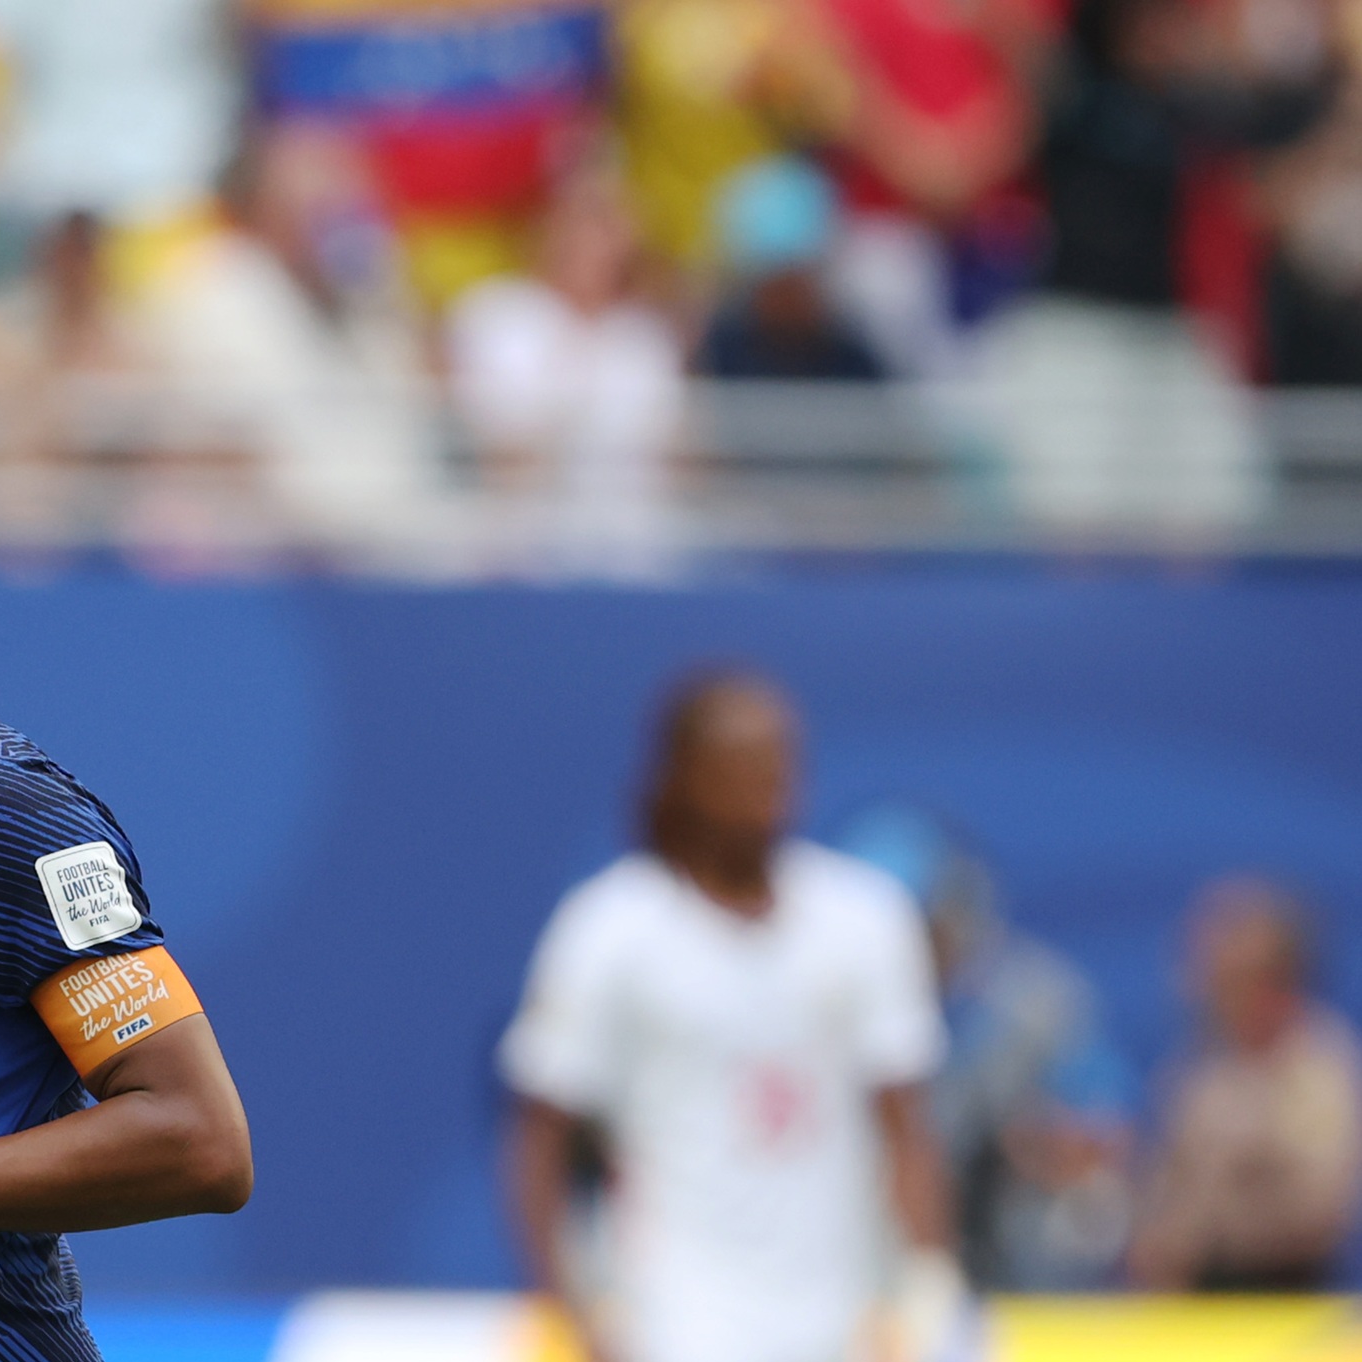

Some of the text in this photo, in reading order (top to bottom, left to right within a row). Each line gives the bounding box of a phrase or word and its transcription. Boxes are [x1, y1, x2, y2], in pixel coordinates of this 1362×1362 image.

[56, 858, 109, 883] FOOTBALL
[62, 872, 115, 902] UNITES
[66, 892, 122, 922] the World
[89, 914, 110, 927] FIFA
[59, 952, 140, 997] FOOTBALL
[68, 960, 155, 1017] UNITES
[79, 980, 170, 1041] the World
[117, 1017, 151, 1040] FIFA
